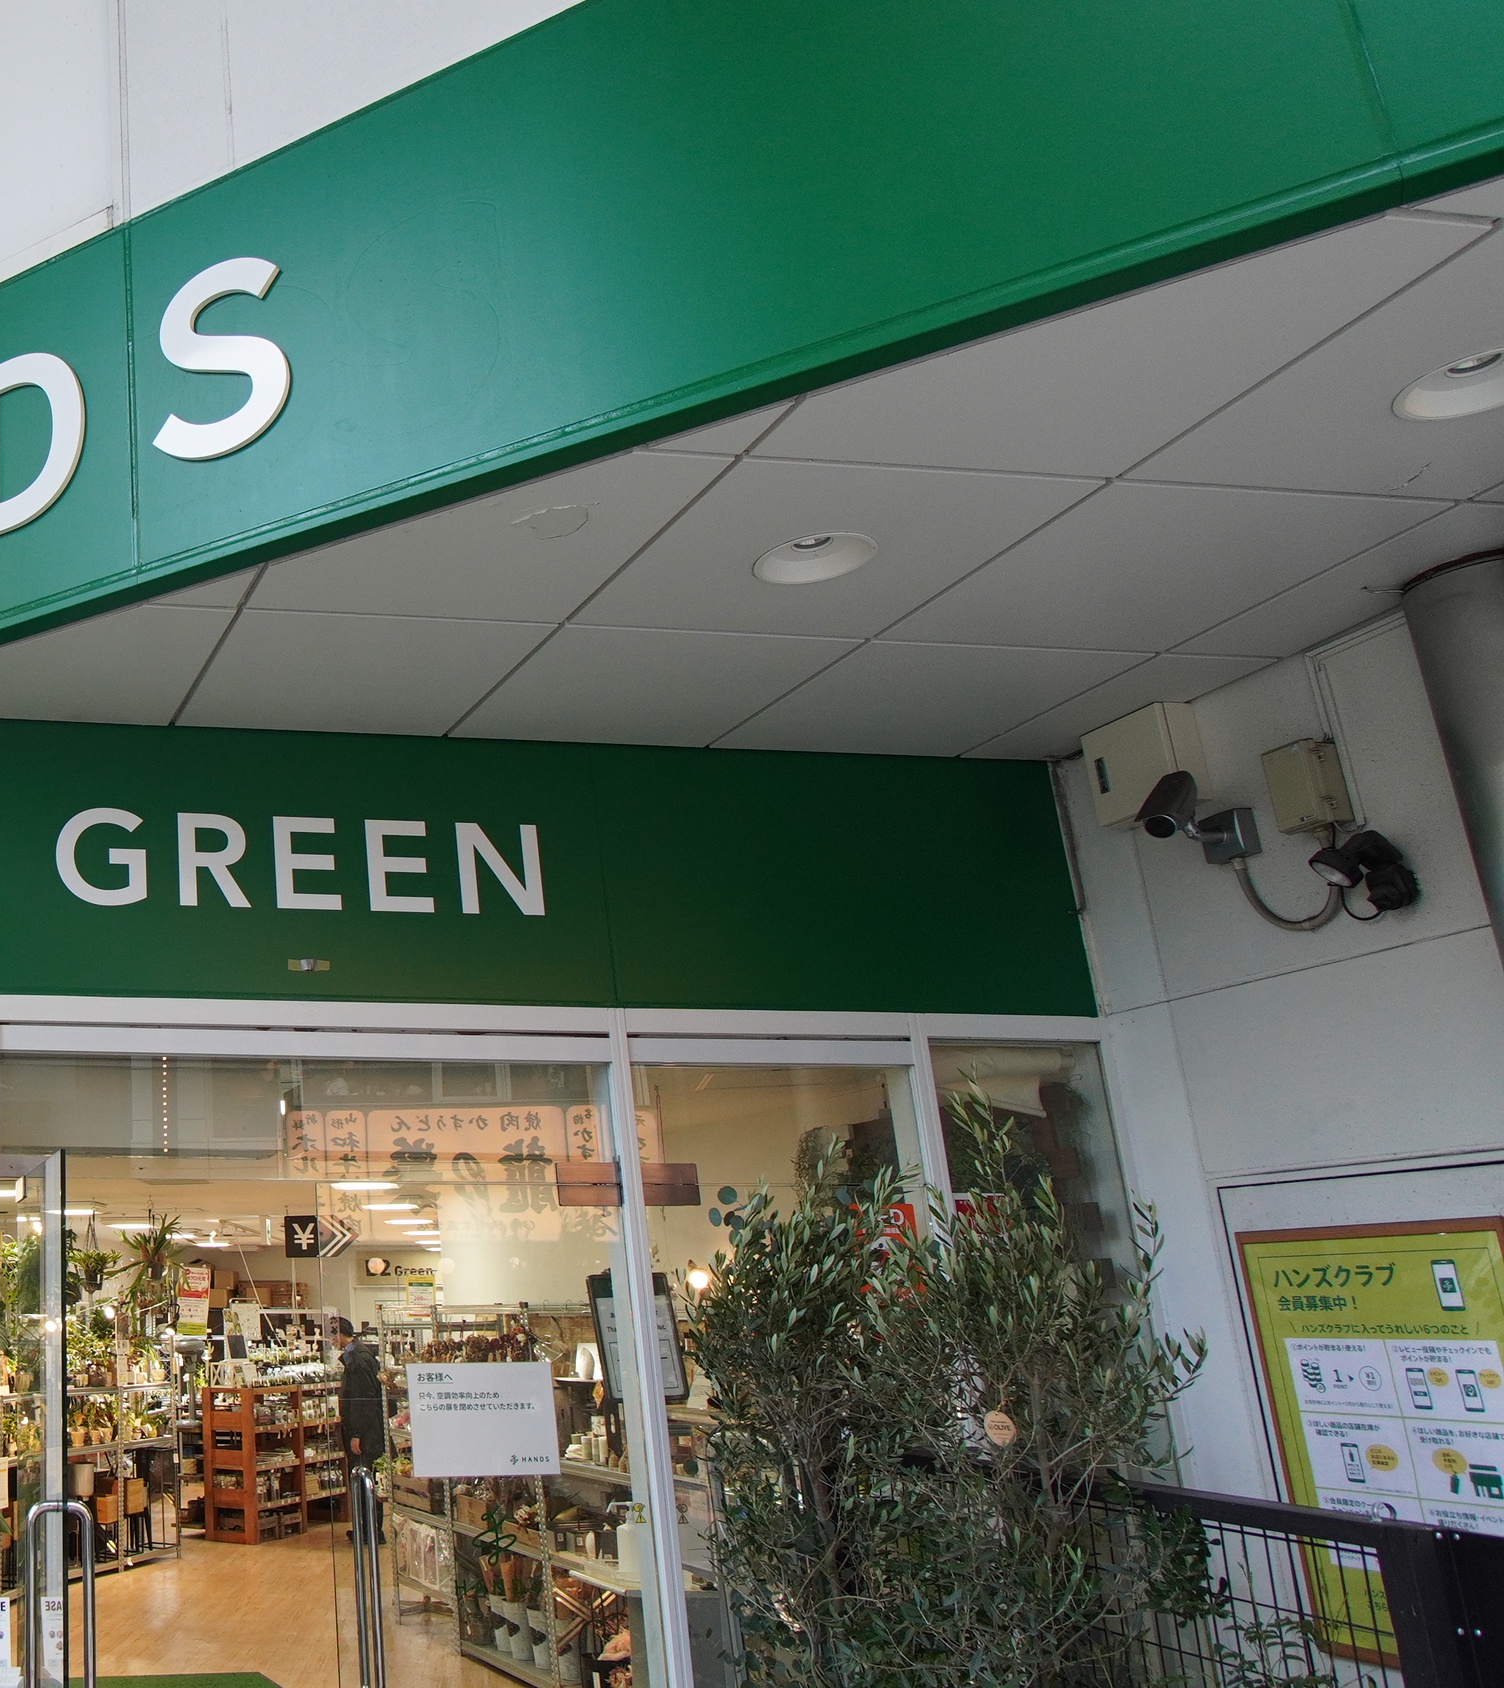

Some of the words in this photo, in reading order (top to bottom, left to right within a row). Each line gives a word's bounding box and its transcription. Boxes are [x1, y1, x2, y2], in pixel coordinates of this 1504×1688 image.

[55, 807, 546, 916] GREEN
[1273, 1262, 1396, 1288] ハンズクラブ
[1277, 1295, 1358, 1312] 会員募集中!
[416, 1372, 453, 1382] お客様へ
[1332, 1369, 1343, 1382] 1
[418, 1391, 500, 1400] 只今、空調効率向上のため
[420, 1402, 535, 1411] こちらの扉を閉めさせていただきます。
